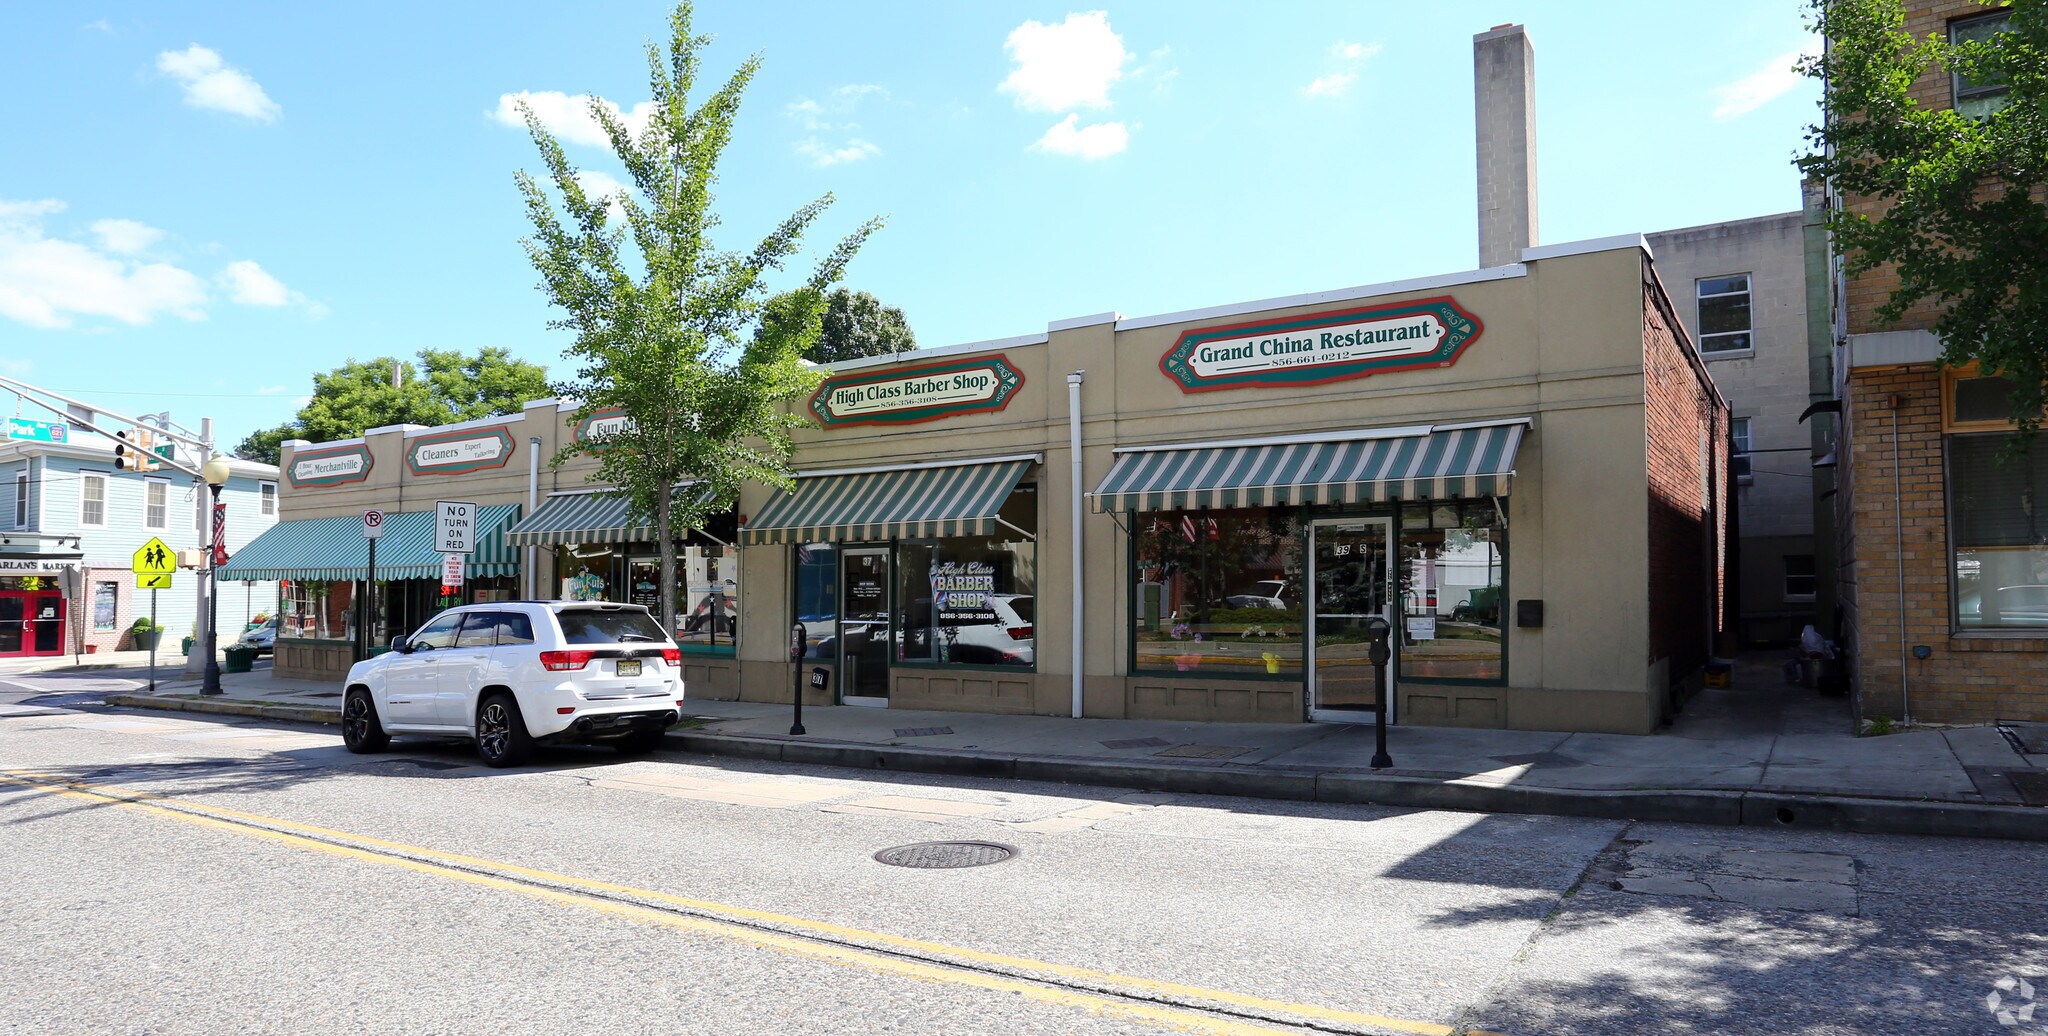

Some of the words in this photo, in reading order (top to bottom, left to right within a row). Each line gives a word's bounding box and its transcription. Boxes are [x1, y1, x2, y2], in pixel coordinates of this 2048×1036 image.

[1199, 342, 1254, 363] Grand
[1260, 336, 1313, 356] China
[1320, 320, 1431, 350] Restaurant
[1271, 352, 1350, 367] 856-661-0212
[836, 388, 864, 407] High
[867, 385, 901, 401] Class
[904, 379, 950, 396] Barber
[953, 374, 988, 391] Shop
[880, 396, 937, 408] 856-356-3108
[10, 422, 35, 436] Park
[596, 422, 618, 435] Fun
[464, 442, 481, 452] Expert
[422, 448, 459, 461] Cleaners
[474, 449, 496, 459] Tailoring
[314, 459, 358, 474] Merchantville
[447, 506, 466, 517] NO
[444, 519, 468, 528] TURN
[448, 529, 463, 538] ON
[446, 540, 464, 549] RED
[1337, 545, 1350, 555] 39
[1360, 544, 1367, 553] S
[862, 556, 872, 566] 37
[937, 561, 966, 577] High
[967, 561, 995, 575] Class
[568, 577, 584, 591] Fun
[936, 575, 995, 591] BARBER
[948, 592, 986, 609] SHOP
